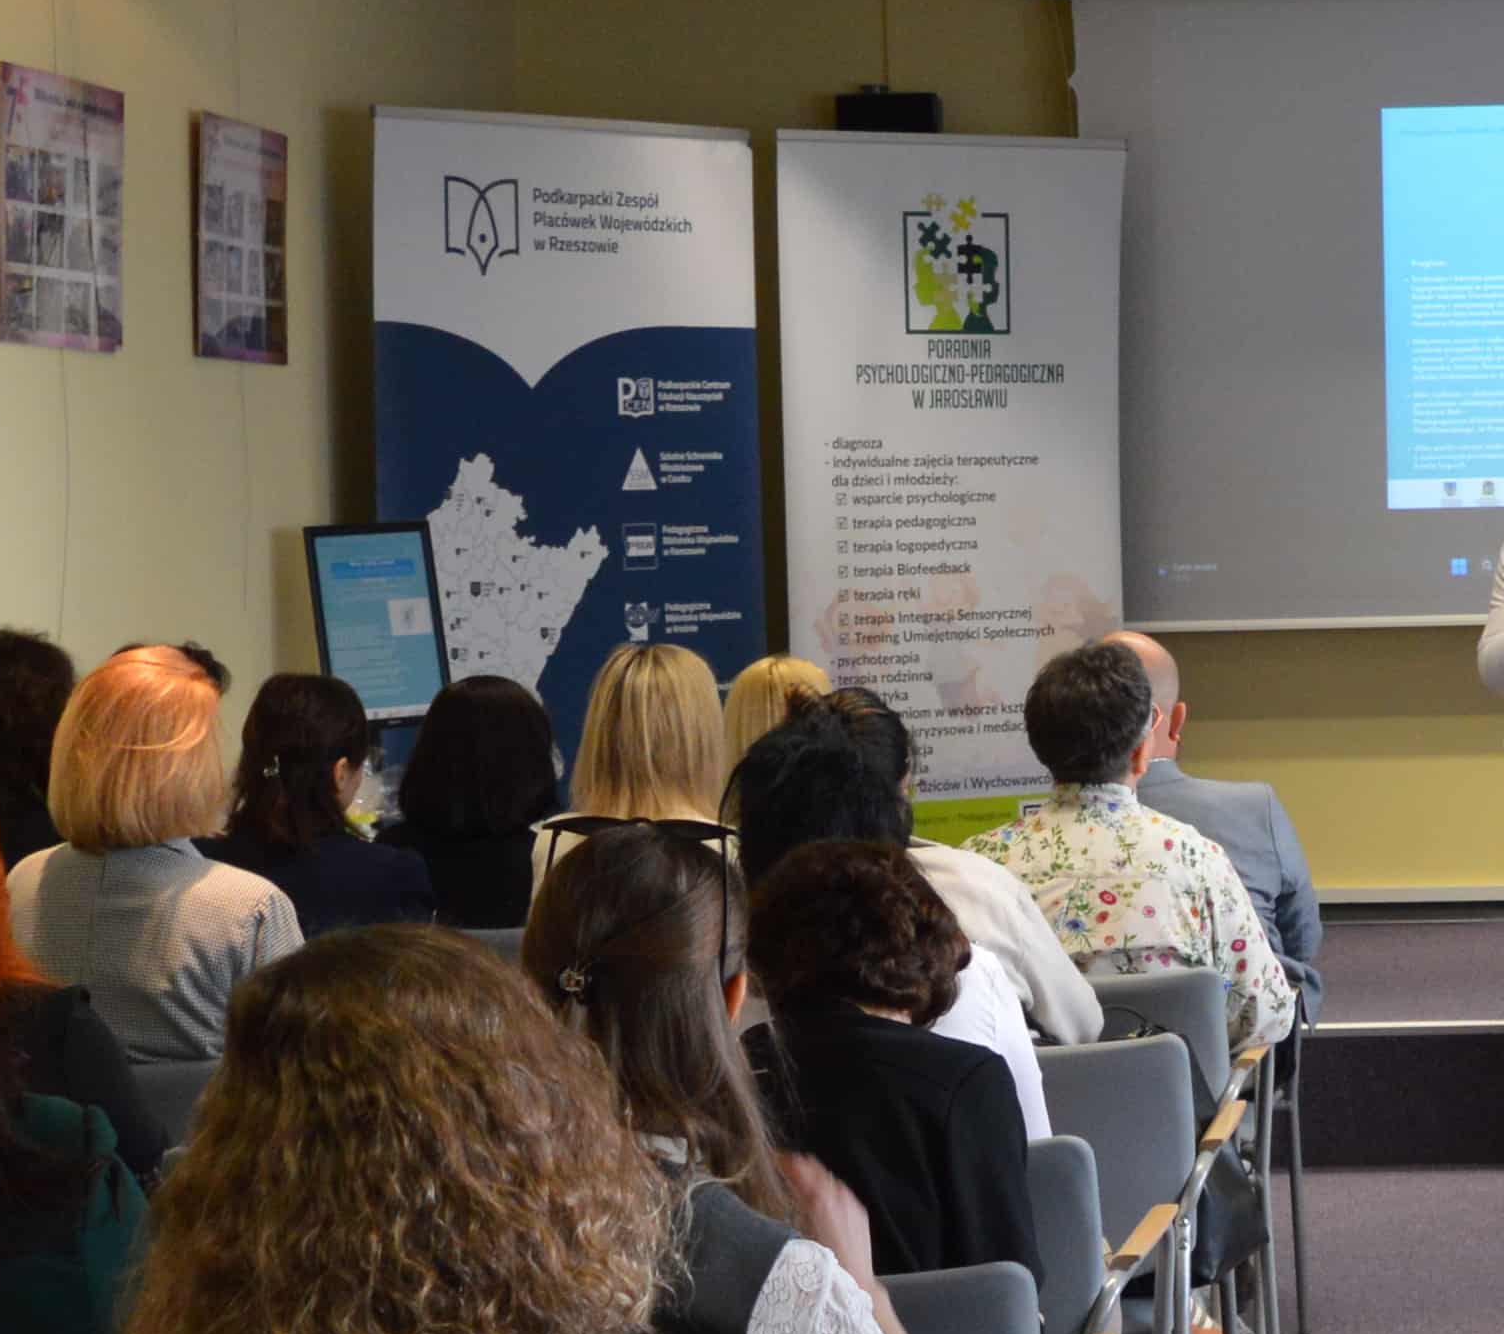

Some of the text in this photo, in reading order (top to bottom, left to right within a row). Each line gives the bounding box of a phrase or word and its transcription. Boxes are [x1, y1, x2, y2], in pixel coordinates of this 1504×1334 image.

[532, 188, 659, 211] Podkarpacki Zespół
[532, 211, 692, 234] Placówek Wojewódzkich
[533, 236, 619, 254] w Rzeszowie
[927, 339, 991, 359] PORADNIA
[855, 364, 1065, 385] PSYCHOLOGICZNO-PEDAGOGICZNA
[912, 388, 1008, 409] W JAROSŁAWIU
[832, 438, 883, 452] diagnoza
[833, 454, 1039, 469] indywidualne zajęcia terapeutyczne
[832, 475, 849, 487] dla
[851, 474, 884, 487] dzieci
[893, 473, 959, 488] młodzieży:
[852, 491, 996, 507] wsparcie psychologiczne
[853, 516, 977, 532] terapia pedagogiczna
[853, 539, 978, 555] terapia logopedyczna
[853, 562, 971, 579] terapia Biofeedback
[853, 588, 921, 603] terapia ręki
[854, 607, 1033, 627] terapia Integracji Sensorycznej
[855, 624, 1055, 645] Trening Umiejętności Społecznych
[838, 652, 920, 668] psychoterapia
[838, 671, 933, 686] terapia rodzinna
[934, 708, 946, 718] w
[948, 704, 997, 720] wyborze
[918, 777, 961, 793] dziców
[970, 773, 1052, 791] Wychowawcó
